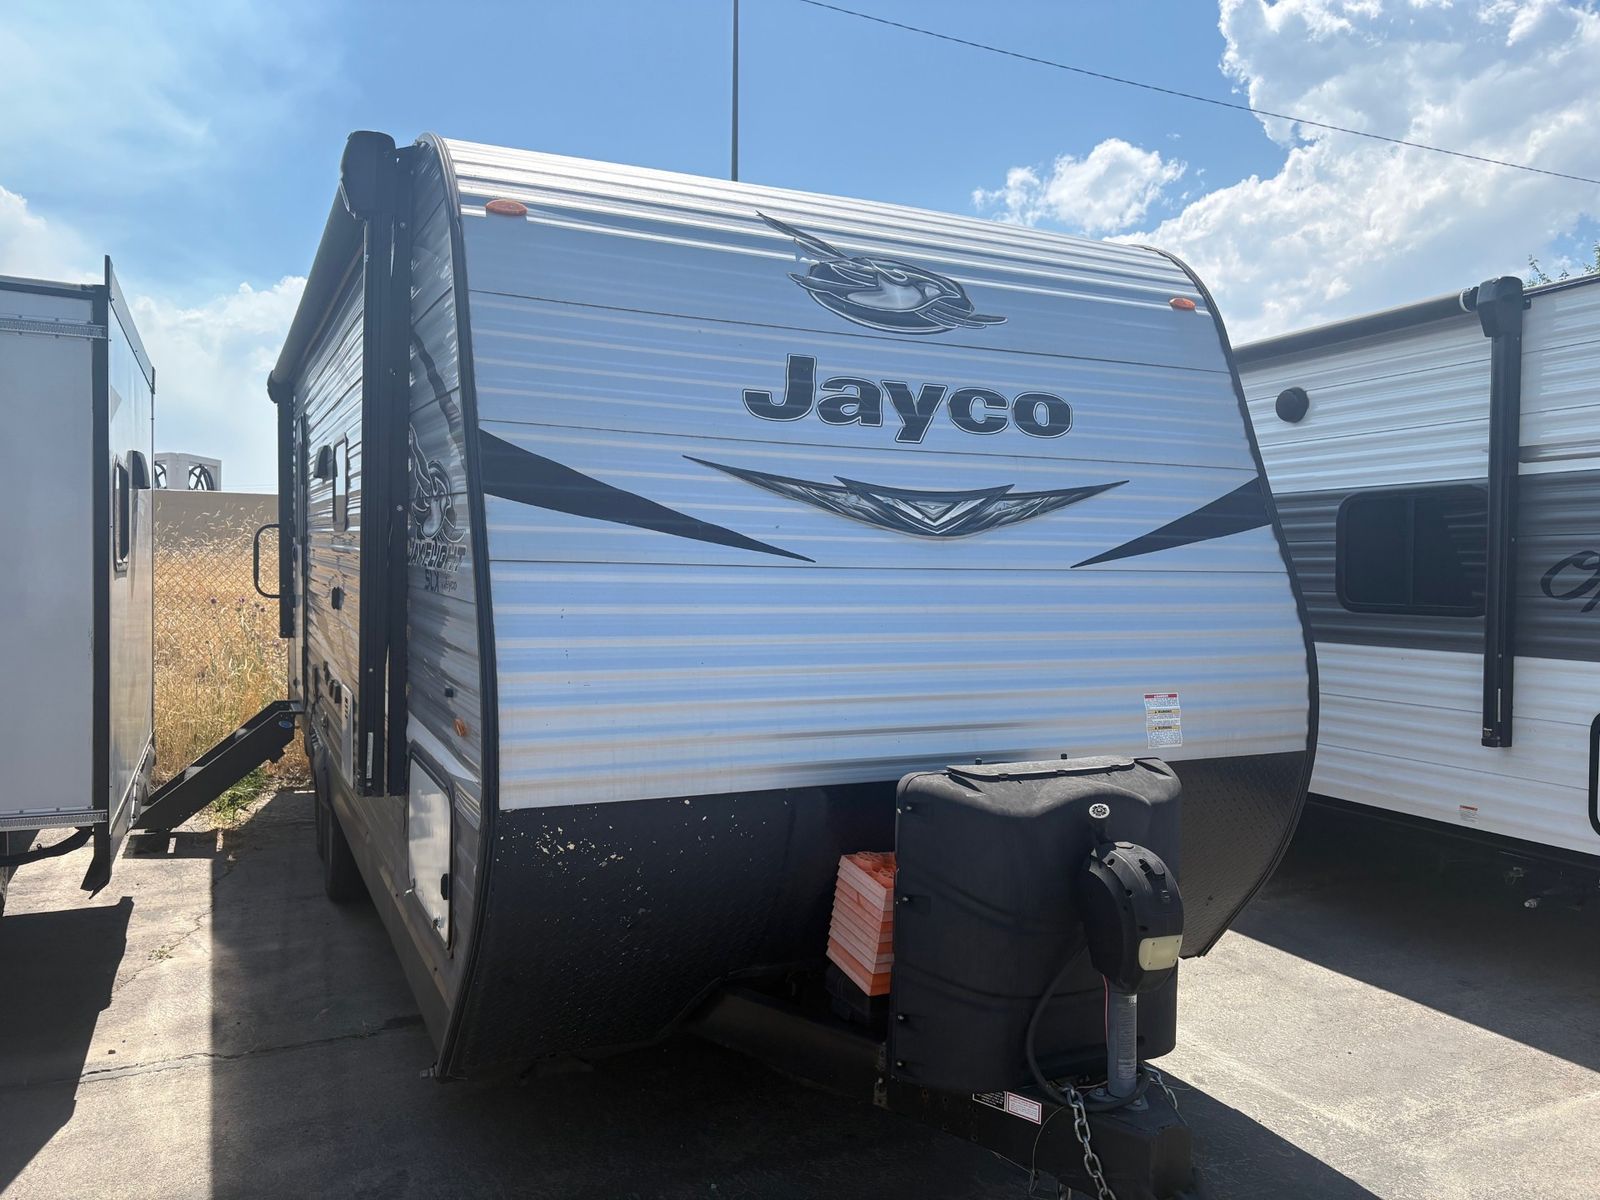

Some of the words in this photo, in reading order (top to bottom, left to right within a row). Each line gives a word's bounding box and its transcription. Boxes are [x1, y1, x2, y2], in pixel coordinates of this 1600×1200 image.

[742, 353, 1073, 444] Jayco
[424, 568, 440, 593] SLX
[1540, 550, 1600, 613] O
